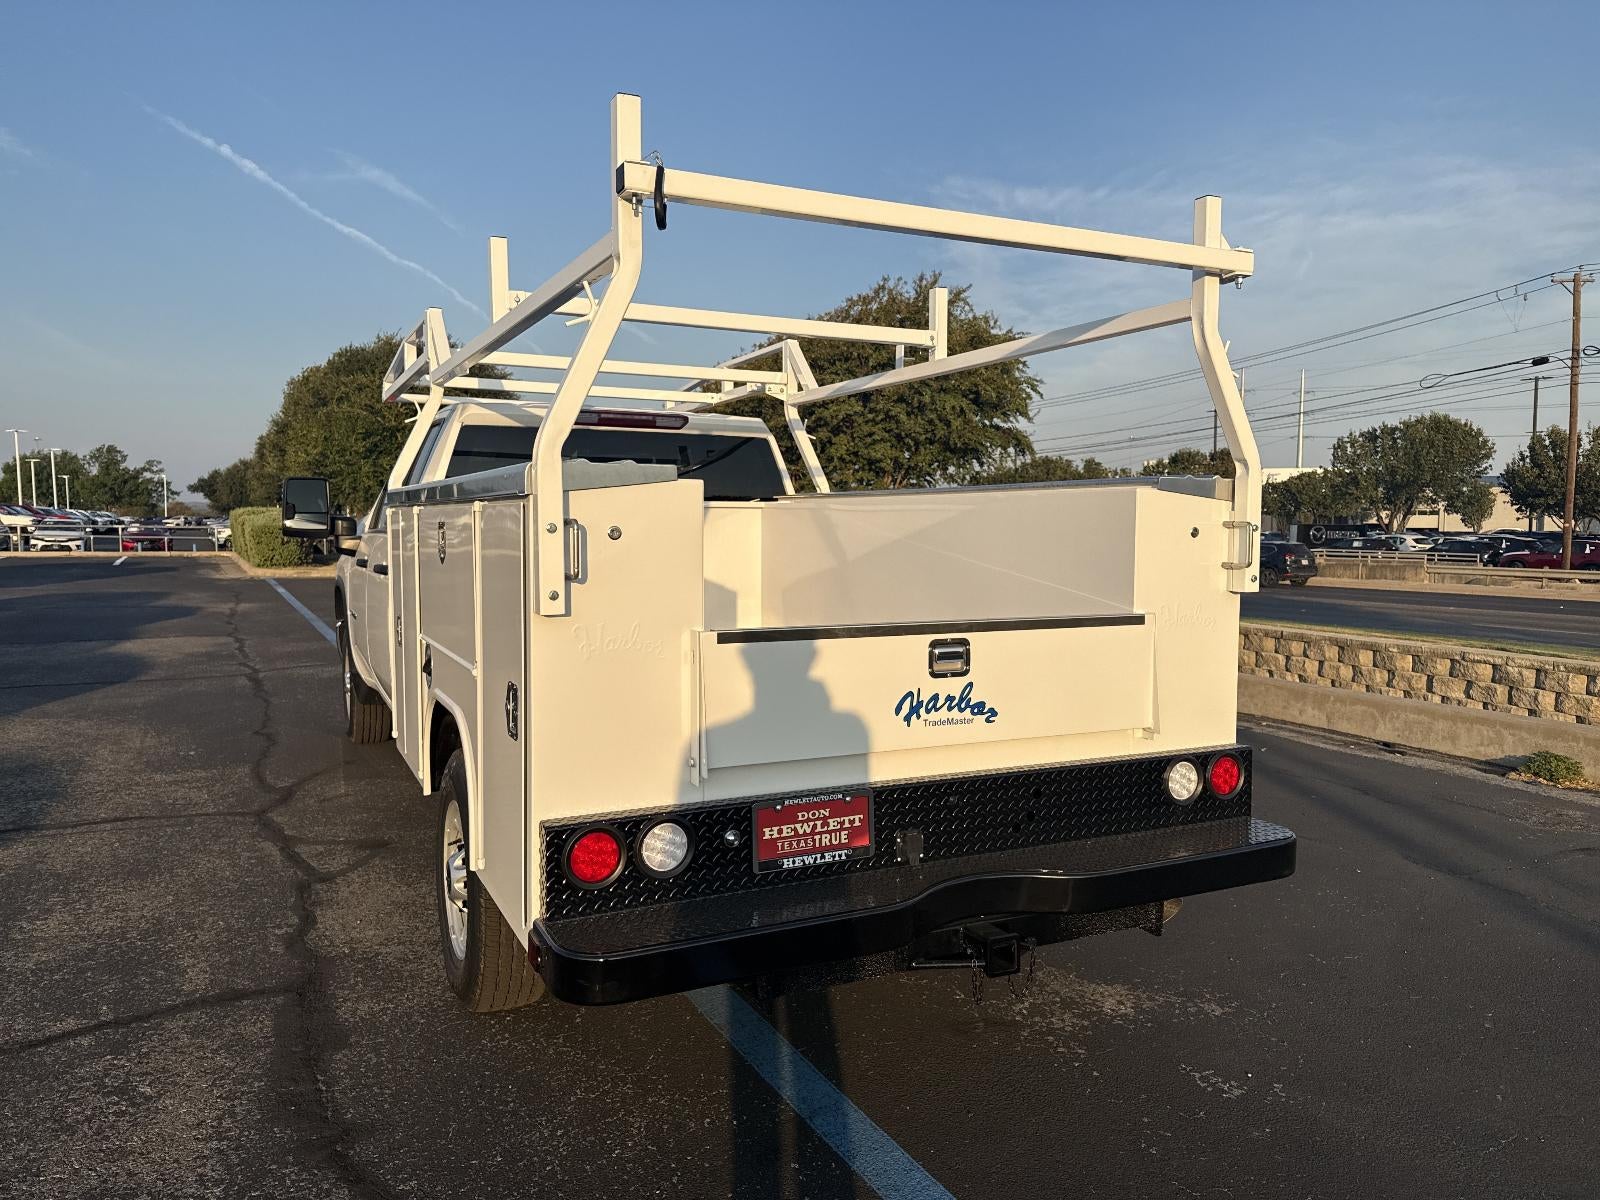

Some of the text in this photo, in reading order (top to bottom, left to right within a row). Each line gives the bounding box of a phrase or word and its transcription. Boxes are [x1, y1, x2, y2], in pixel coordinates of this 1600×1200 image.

[923, 717, 974, 727] TradeMaster
[784, 793, 843, 806] HEWLETTAUTO.COM
[797, 808, 831, 821] DON
[762, 814, 864, 840] HEWLETT
[782, 849, 848, 869] HEWLETT
